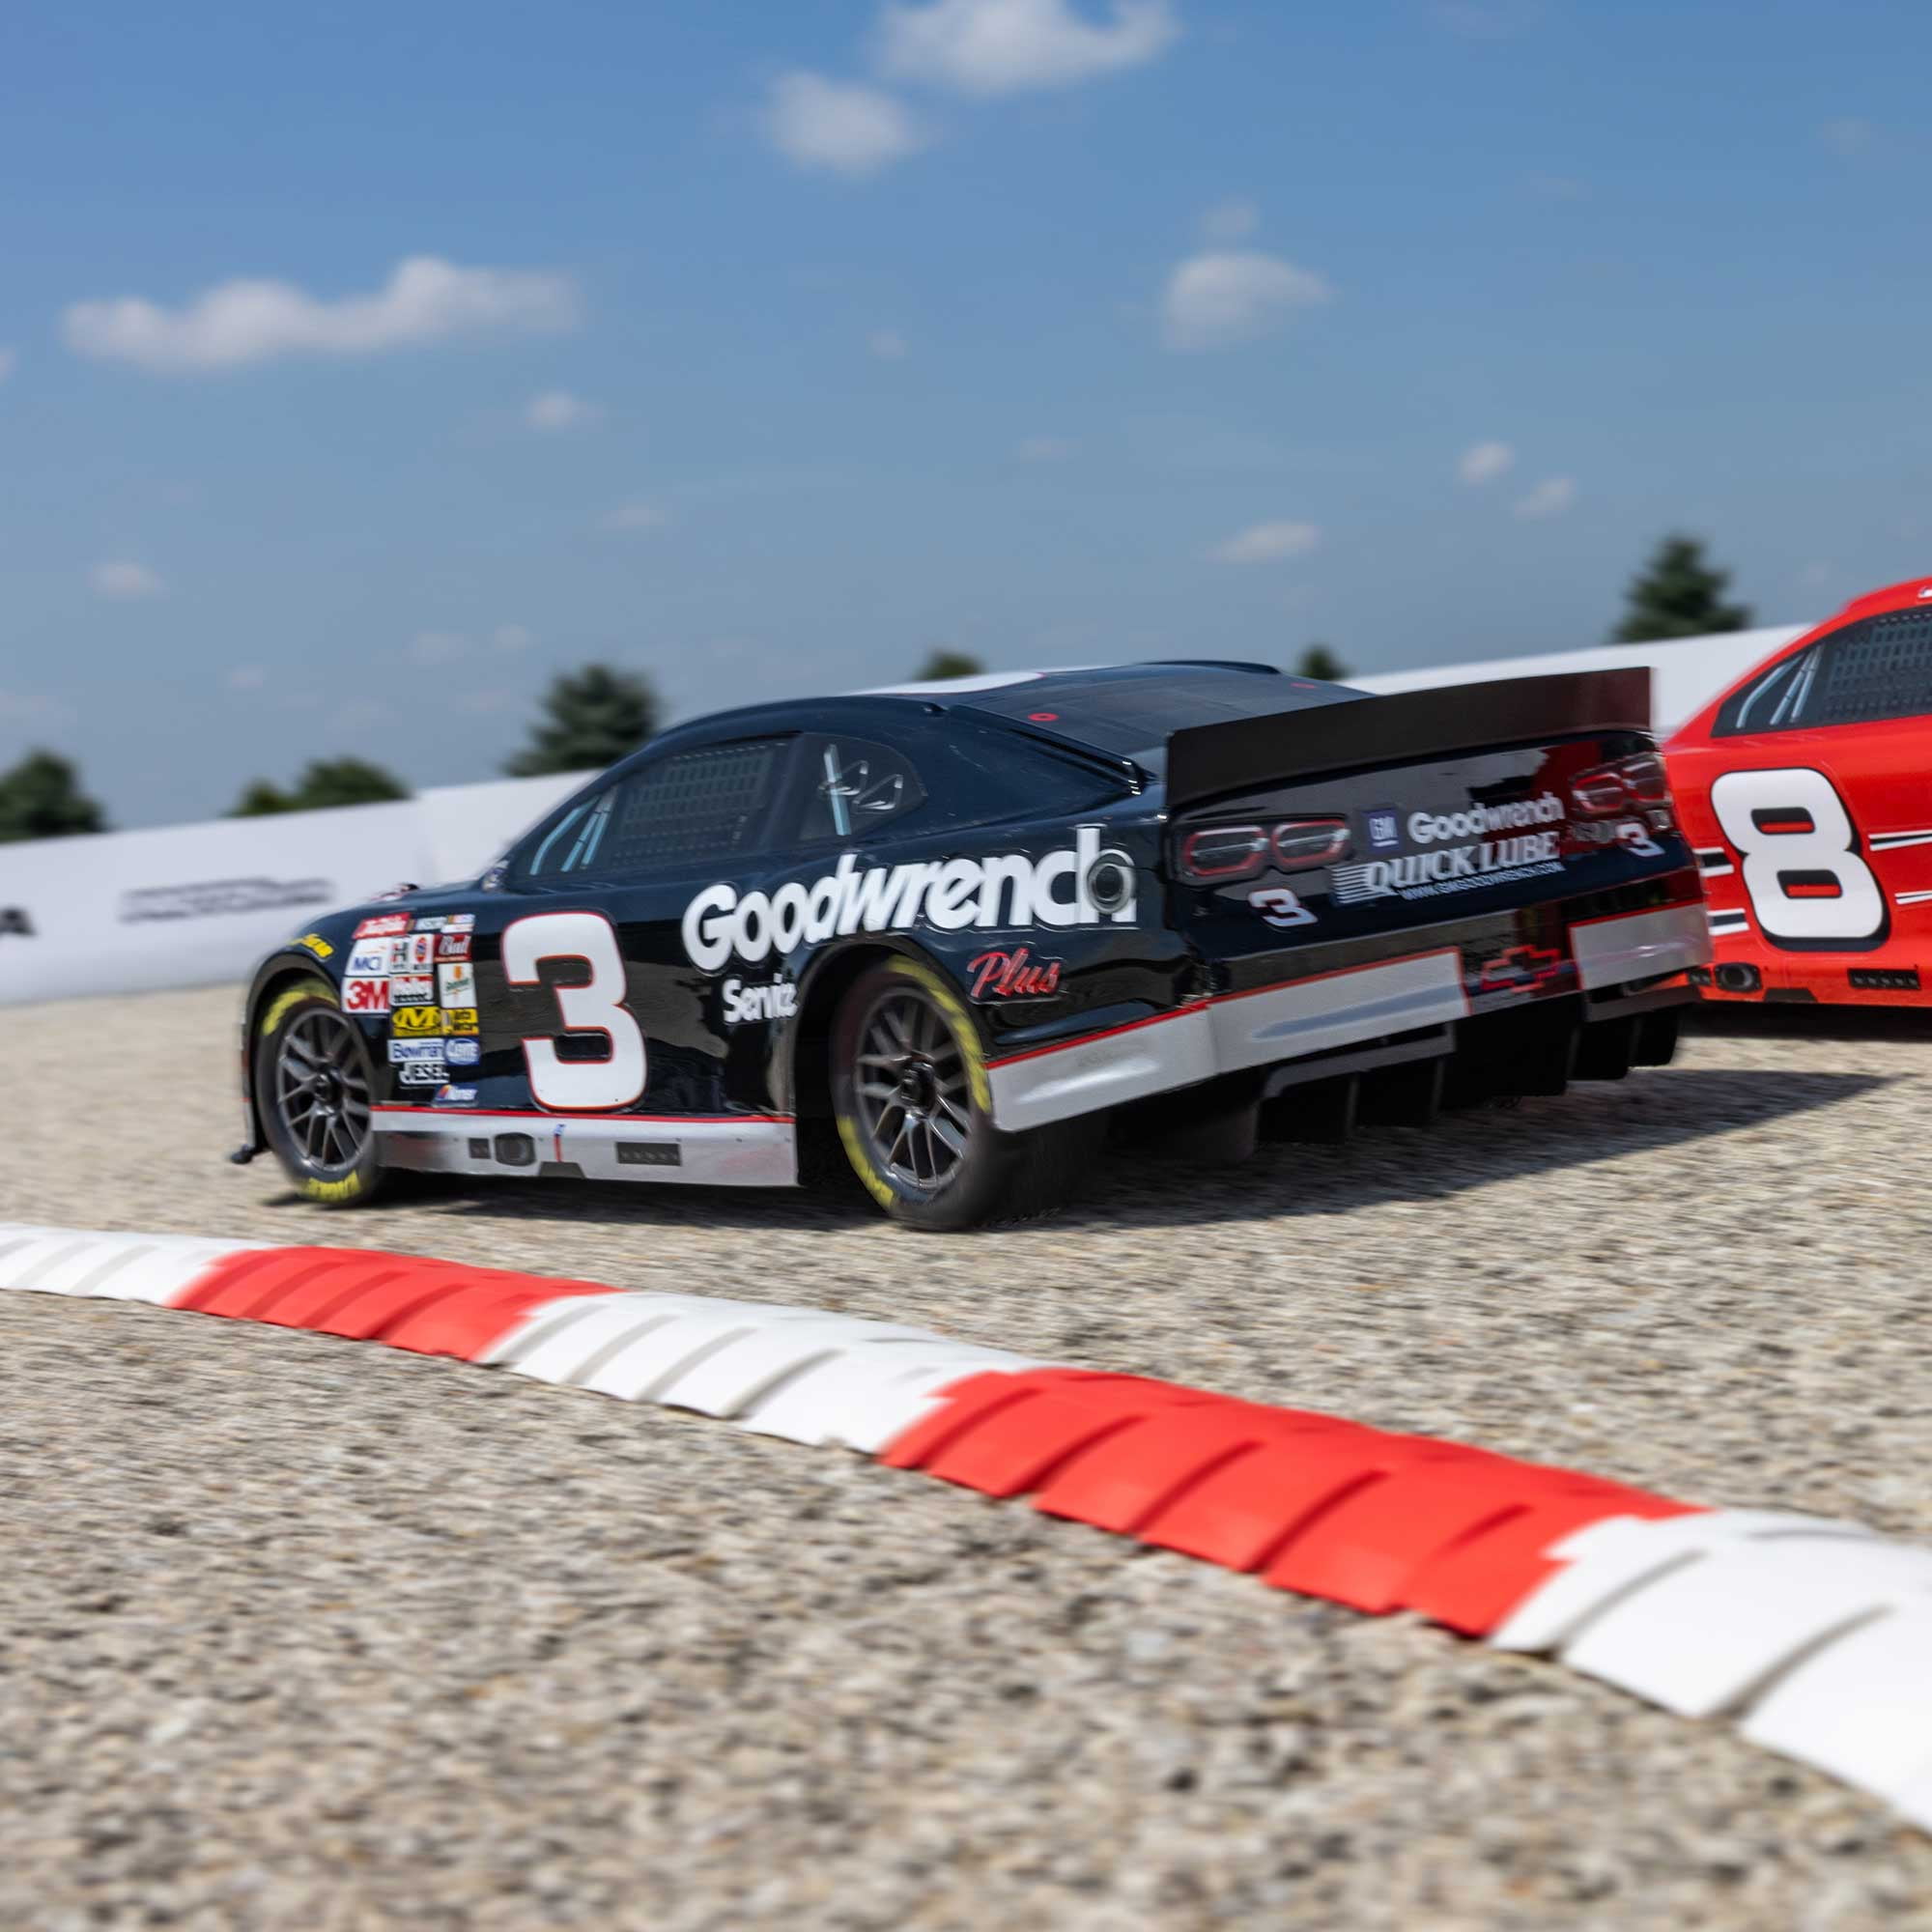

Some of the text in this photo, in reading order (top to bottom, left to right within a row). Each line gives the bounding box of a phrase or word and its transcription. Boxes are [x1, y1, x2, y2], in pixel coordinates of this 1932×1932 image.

[1406, 790, 1565, 844] Goodwrench
[1616, 821, 1665, 857] 3
[1365, 830, 1561, 895] QUICK LUBE
[1710, 768, 1891, 952] 8
[682, 827, 1137, 971] Goodwrench
[1248, 887, 1320, 928] 3
[354, 955, 383, 970] MCI
[967, 947, 1060, 999] Plus
[347, 980, 390, 1010] 3M
[501, 910, 648, 1111] 3
[399, 1062, 450, 1084] JESEL
